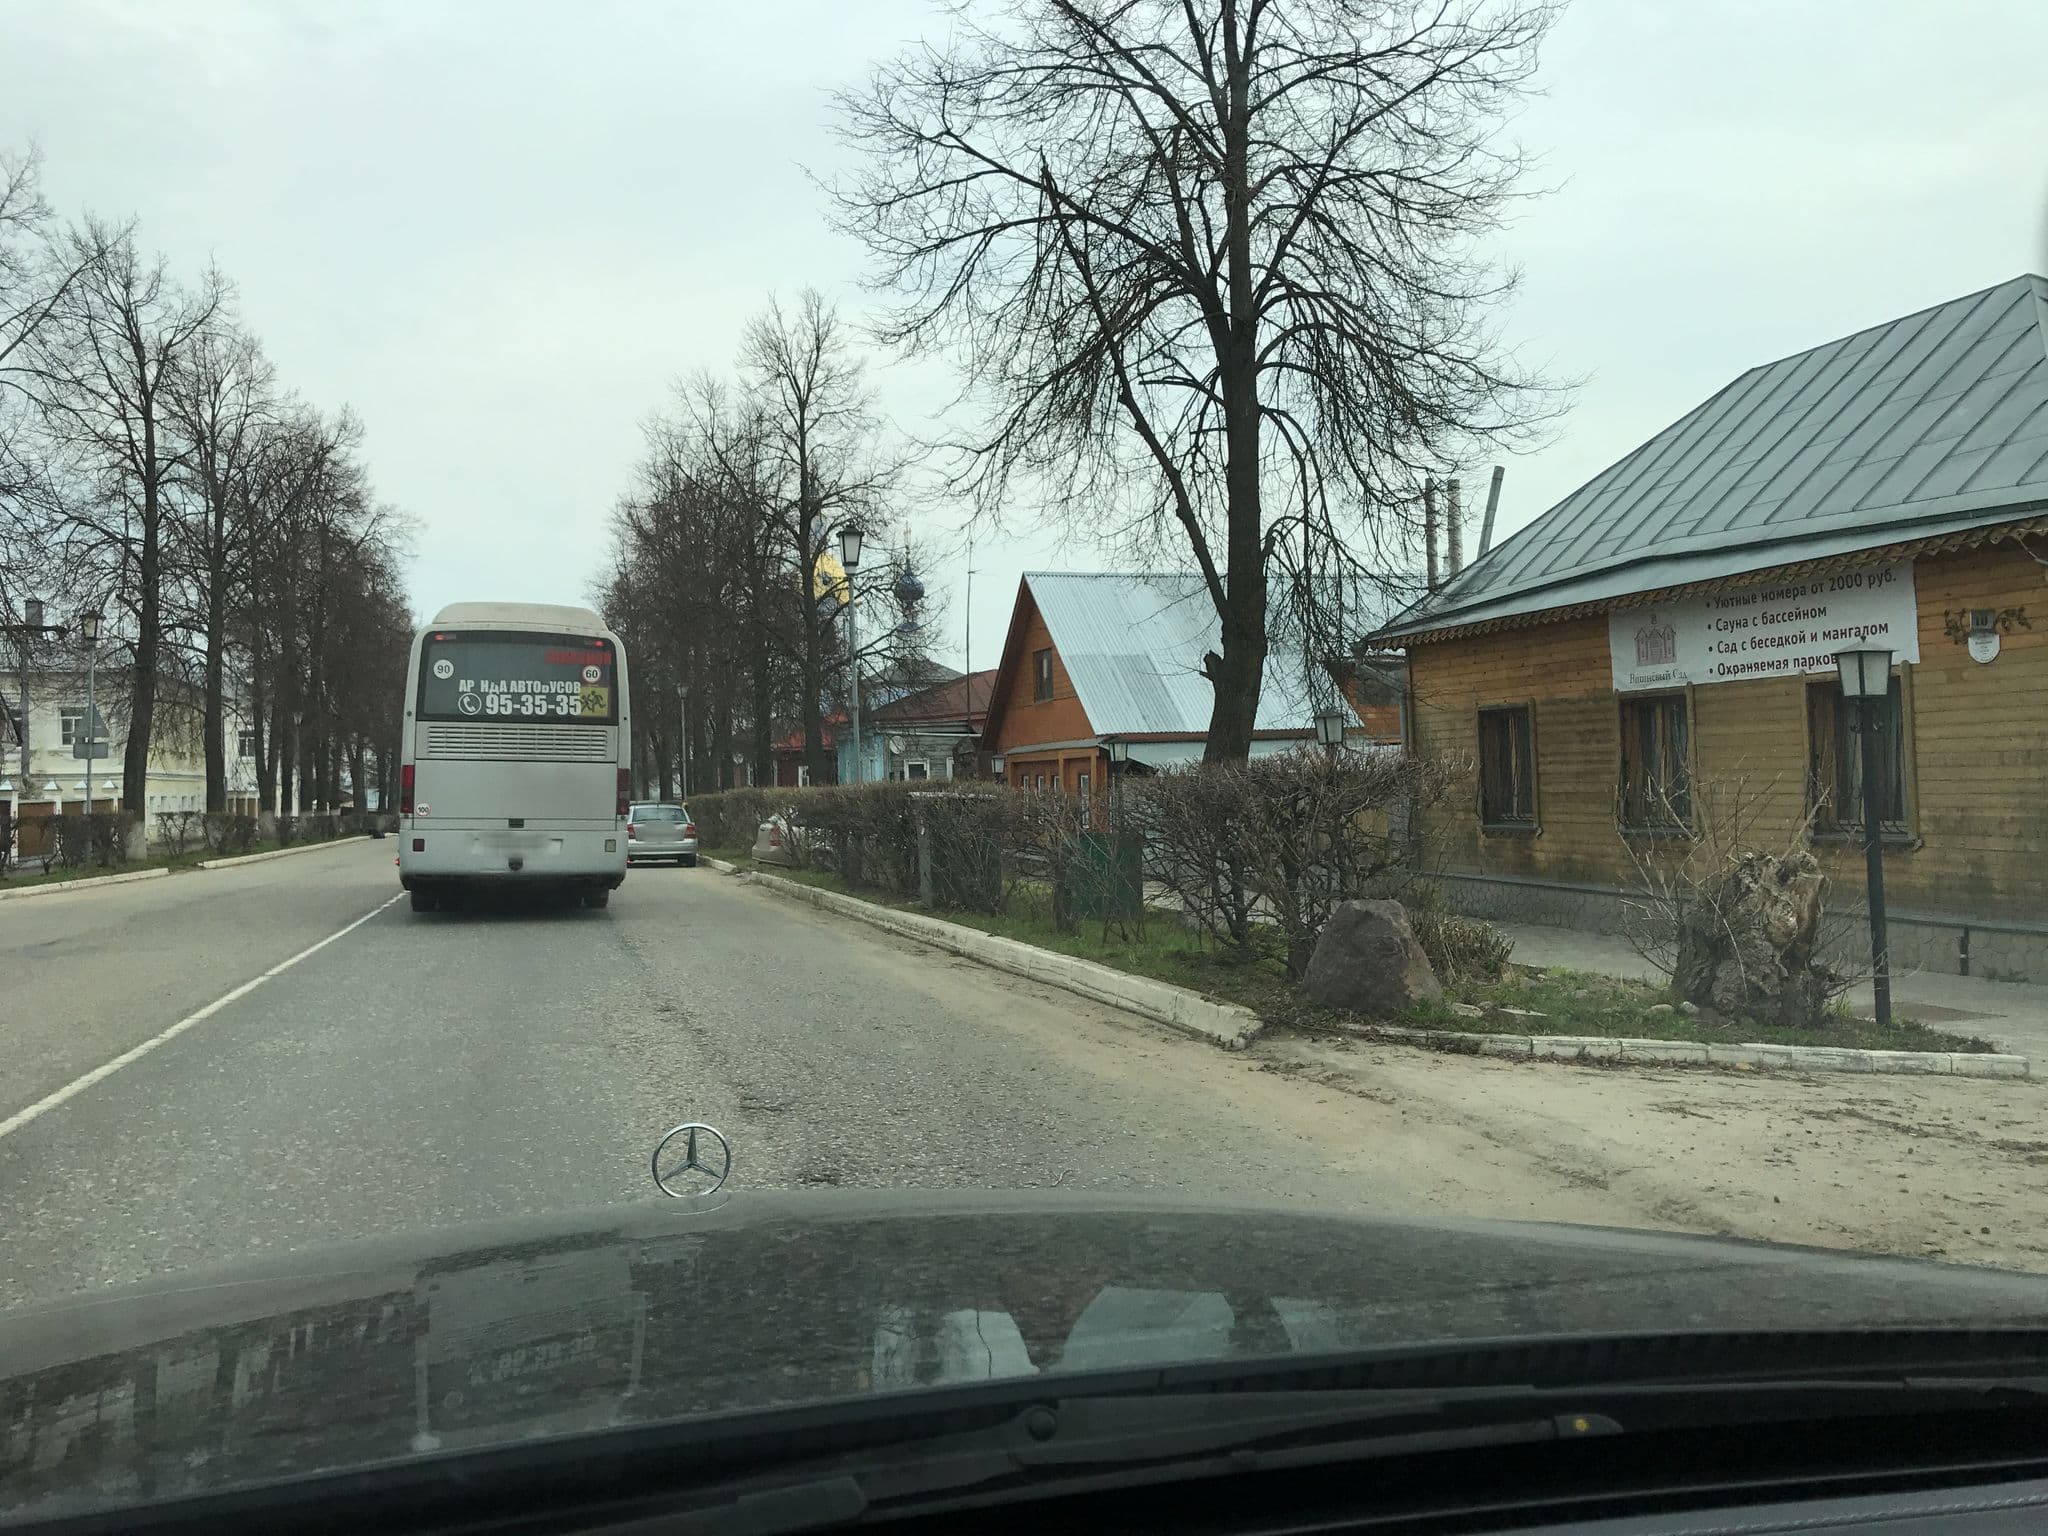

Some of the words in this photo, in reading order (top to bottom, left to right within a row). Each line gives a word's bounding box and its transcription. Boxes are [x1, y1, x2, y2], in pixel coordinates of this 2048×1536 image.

[1713, 592, 1757, 609] Уютные
[1761, 584, 1806, 603] номера
[1811, 582, 1825, 595] от
[1829, 573, 1863, 592] 2000
[1868, 567, 1897, 589] руб.
[1715, 616, 1749, 633] Сауна
[1752, 616, 1758, 627] с
[1761, 605, 1827, 626] бассейном
[1717, 639, 1738, 655] Сад
[1741, 639, 1747, 651] с
[1750, 630, 1806, 650] беседкой
[1810, 630, 1818, 643] и
[1822, 621, 1889, 642] мангалом
[437, 665, 450, 674] 90
[585, 669, 598, 679] 60
[1717, 657, 1789, 677] Охраняемая
[1793, 653, 1838, 671] парков
[485, 693, 582, 716] 95-35-35
